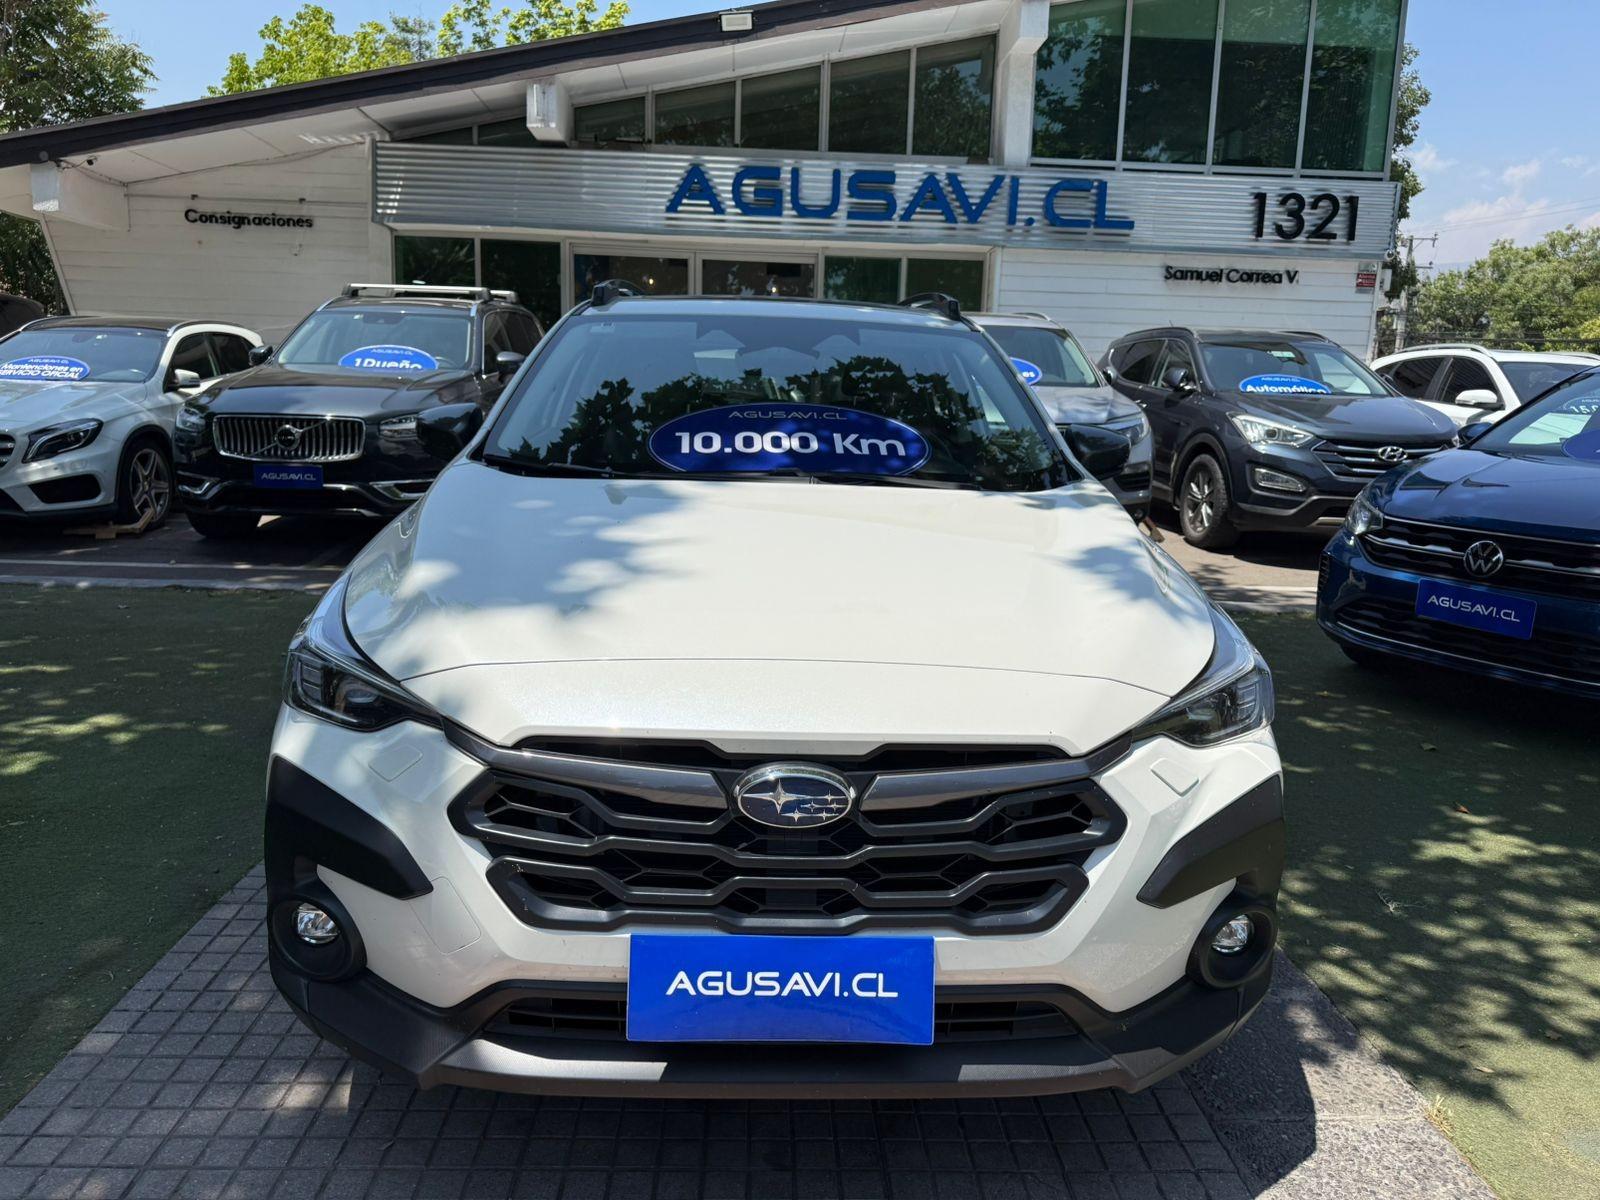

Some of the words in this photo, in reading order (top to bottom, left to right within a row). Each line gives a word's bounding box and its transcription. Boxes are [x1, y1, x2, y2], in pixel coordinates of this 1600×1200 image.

[666, 163, 1134, 230] AGUSAVI.CL
[184, 208, 313, 229] Consignaciones
[1253, 191, 1359, 241] 1321
[1164, 265, 1223, 283] Samuel
[1226, 268, 1283, 284] Correa
[41, 370, 80, 379] OFICIAL
[728, 410, 847, 420] AGUSAVI.CL
[675, 431, 819, 454] 10.000
[833, 432, 906, 457] Km
[261, 472, 316, 481] AGUSAVI.CL
[1427, 595, 1520, 622] AGUSAVI.CL
[665, 970, 899, 998] AGUSAVI.CL
